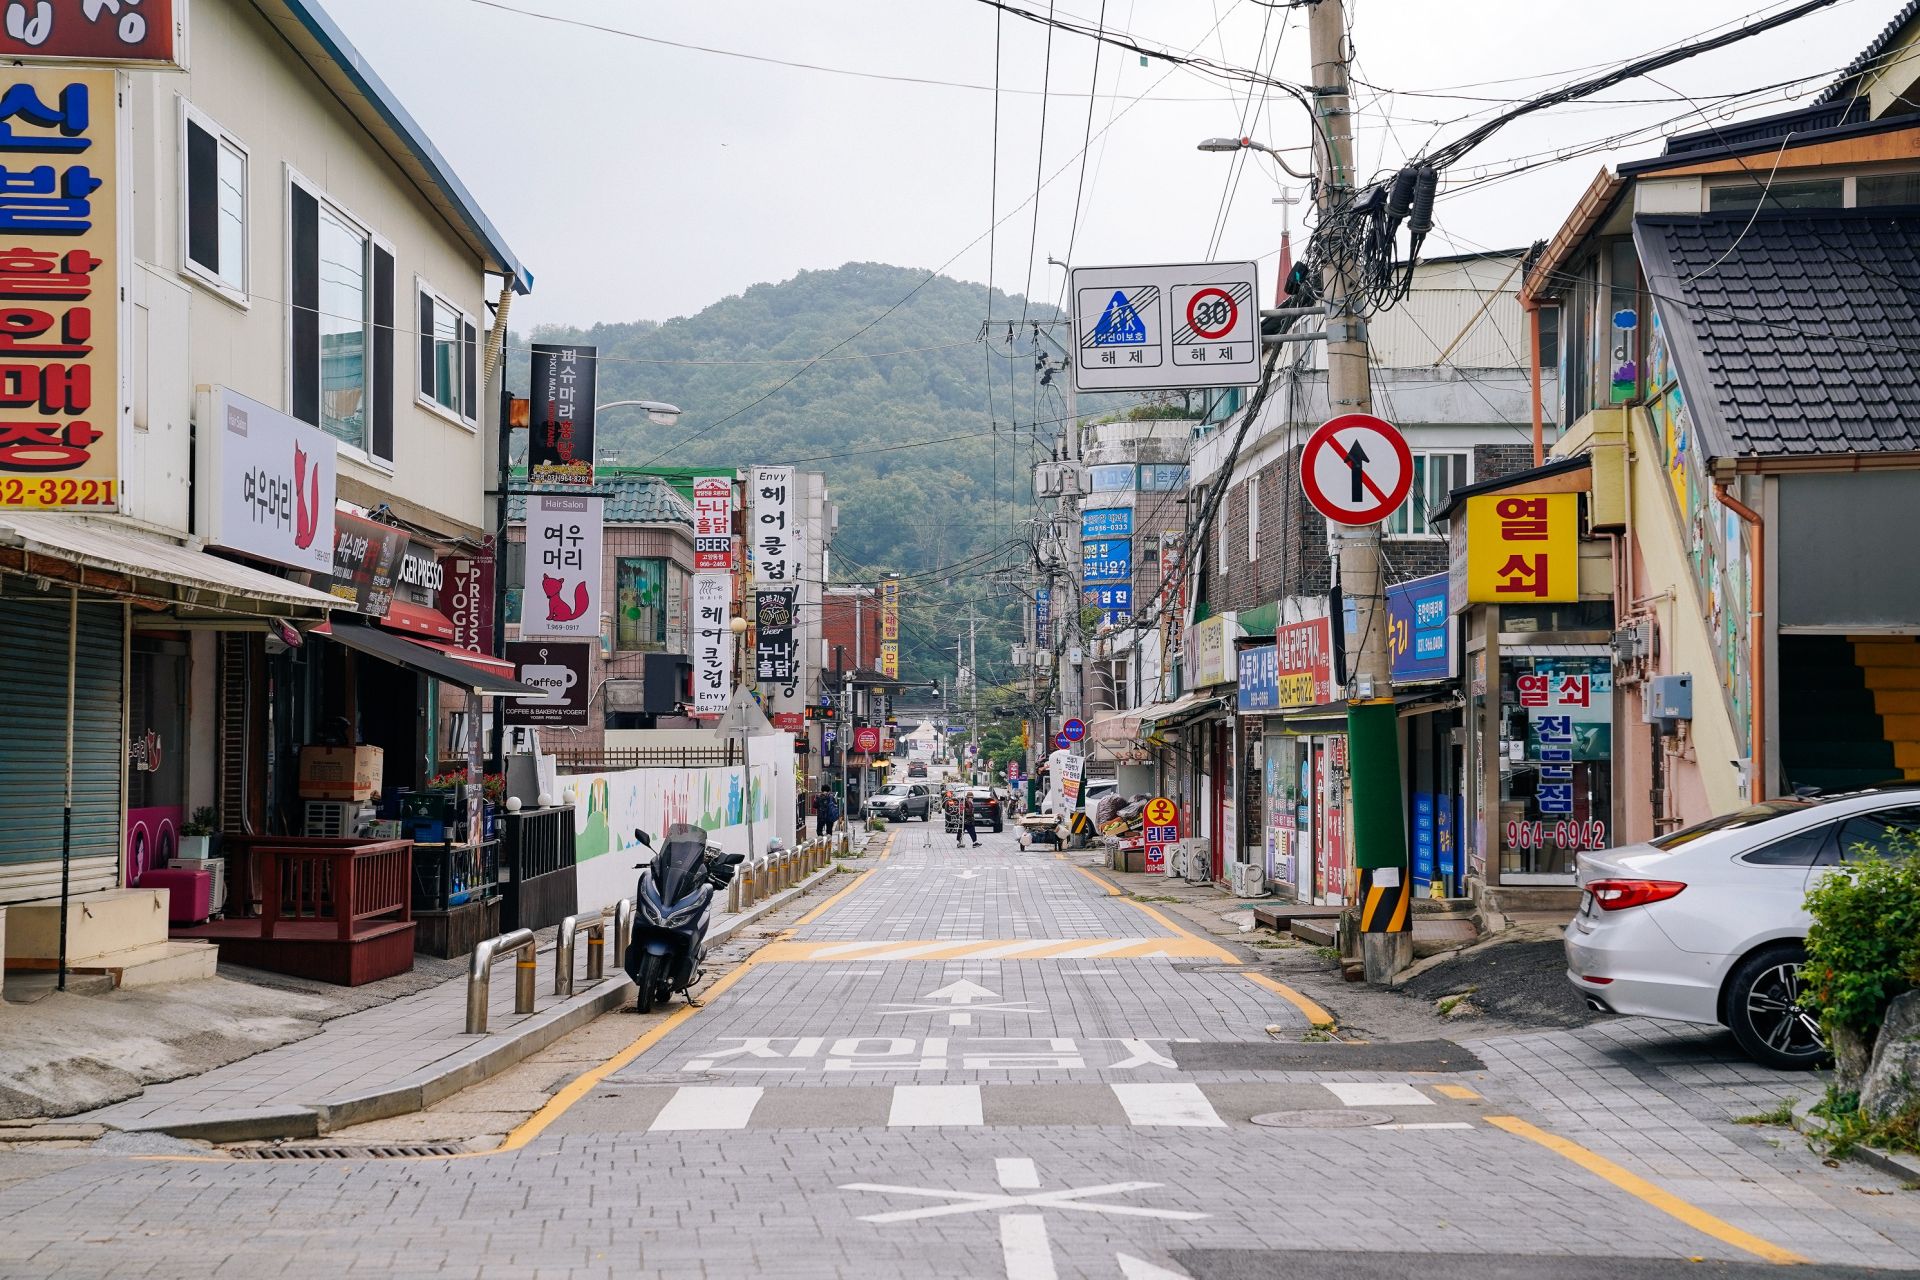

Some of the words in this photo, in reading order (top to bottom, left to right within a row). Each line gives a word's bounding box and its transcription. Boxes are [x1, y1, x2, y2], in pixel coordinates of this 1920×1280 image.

[1197, 301, 1228, 326] 30
[1096, 332, 1145, 343] 어린이보호
[548, 377, 557, 402] MALA
[759, 472, 787, 482] Envy
[244, 465, 292, 533] 여우머리
[545, 500, 562, 508] Hair
[562, 500, 584, 509] Salon
[695, 499, 729, 516] 누나
[696, 517, 729, 534] 홀닭
[759, 485, 787, 580] 헤어클럽
[544, 523, 585, 547] 여우
[696, 538, 730, 552] BEER
[1495, 496, 1549, 598] 열쇠
[543, 548, 582, 570] 머리
[546, 623, 580, 631] T.969-0917
[700, 606, 723, 689] 헤어클럽
[757, 642, 791, 660] 누나
[757, 659, 791, 678] 홀닭
[525, 676, 563, 688] Coffee
[699, 691, 727, 701] Envy
[1516, 674, 1591, 709] 열쇠
[696, 704, 728, 712] 964-7714
[1535, 714, 1574, 814] 전문점
[1146, 826, 1177, 843] 리폼
[1506, 820, 1606, 850] 964-6942
